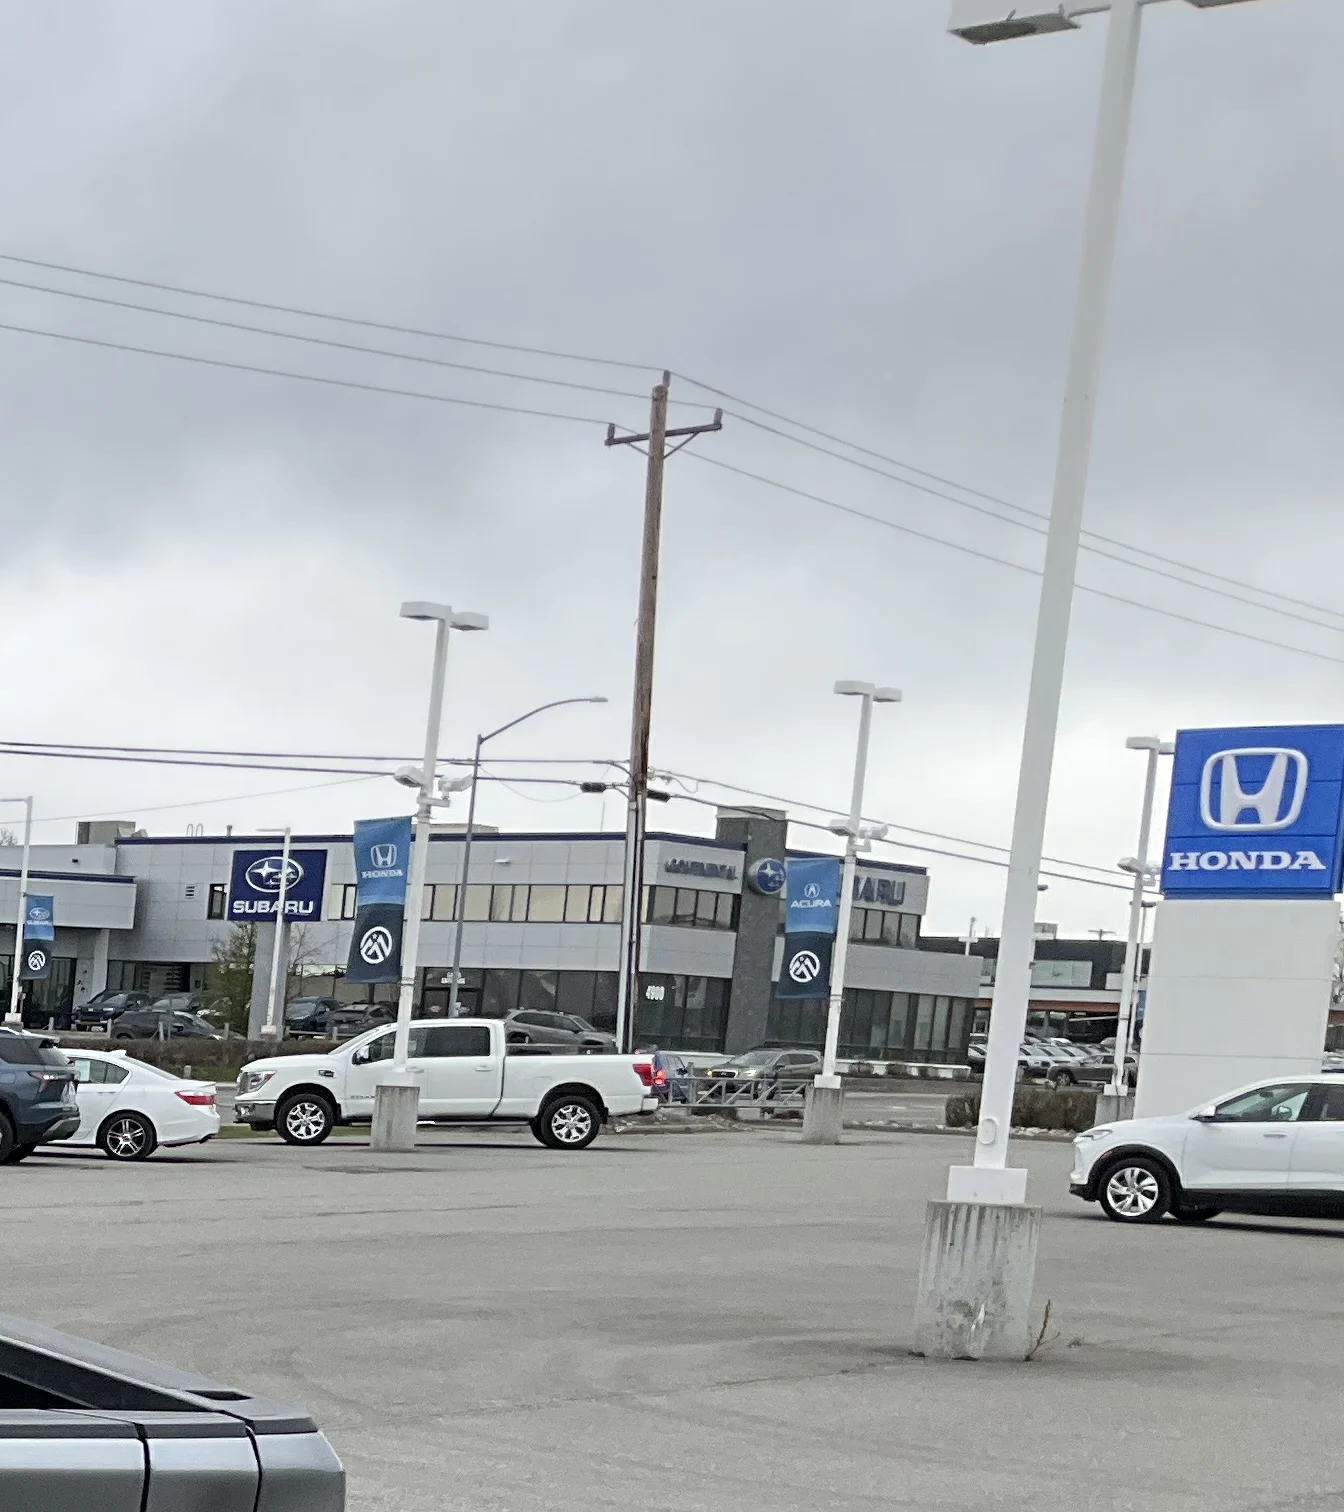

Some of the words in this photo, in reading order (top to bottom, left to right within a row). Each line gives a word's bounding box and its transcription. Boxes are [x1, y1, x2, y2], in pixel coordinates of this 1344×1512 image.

[1167, 851, 1327, 871] HONDA
[361, 869, 404, 879] HONDA
[790, 899, 832, 909] ACURA
